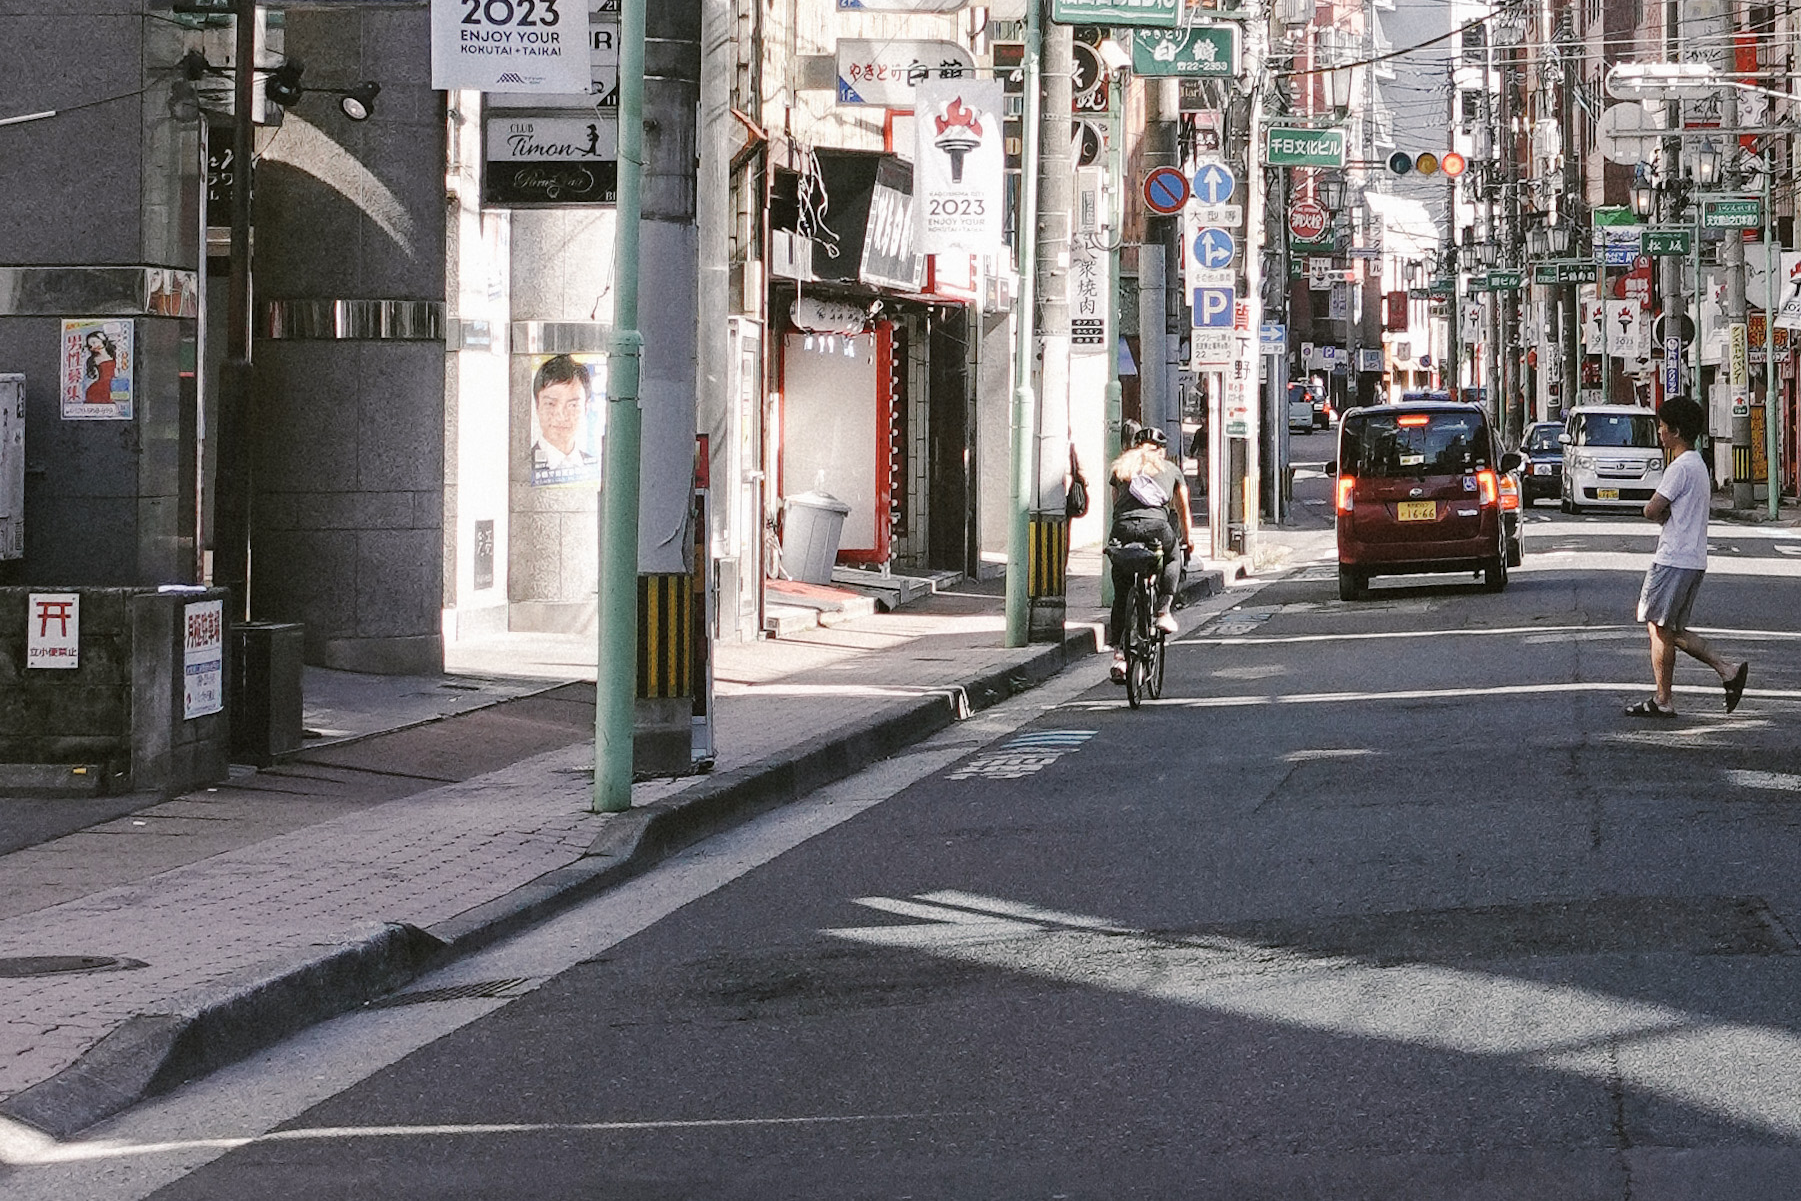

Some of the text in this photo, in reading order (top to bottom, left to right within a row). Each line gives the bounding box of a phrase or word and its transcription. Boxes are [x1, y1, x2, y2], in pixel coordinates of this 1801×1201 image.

[460, 30, 560, 45] ENJOY YOUR
[461, 45, 562, 57] KOKUTAI TAIKAI
[851, 62, 902, 82] やきとり
[840, 90, 855, 101] 1F
[509, 123, 535, 134] CLUB
[507, 135, 577, 157] Timon
[1271, 138, 1342, 156] 千日文化ビル
[929, 199, 986, 216] 2023
[928, 218, 958, 226] ENJOY
[1190, 210, 1236, 223] 大型等
[1291, 215, 1322, 230] 消火栓
[1203, 290, 1228, 325] P
[29, 647, 77, 658] 立小便禁止
